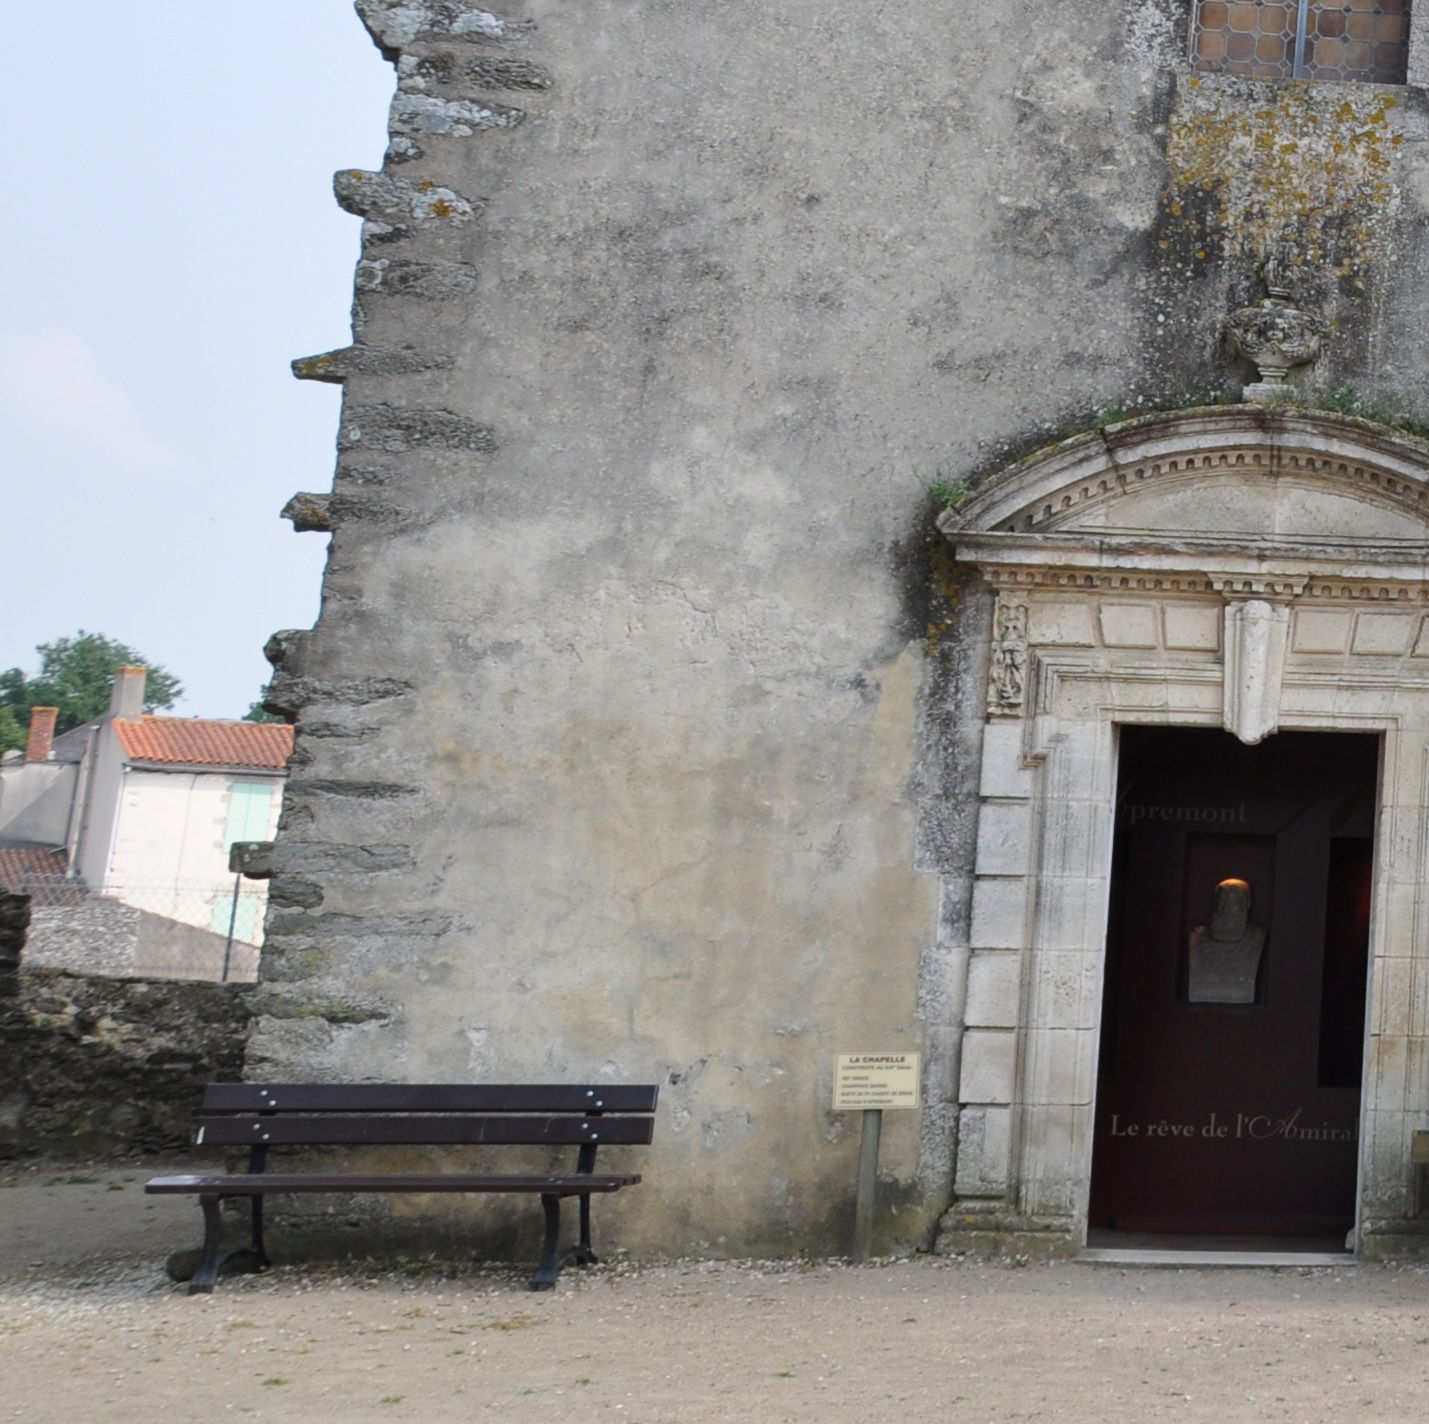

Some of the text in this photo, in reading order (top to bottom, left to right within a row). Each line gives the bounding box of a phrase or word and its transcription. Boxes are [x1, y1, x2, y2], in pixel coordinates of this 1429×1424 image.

[849, 1056, 905, 1064] LA CHAPELLE
[1110, 1114, 1139, 1137] Le
[1146, 1120, 1195, 1138] rêve
[1201, 1113, 1229, 1138] de
